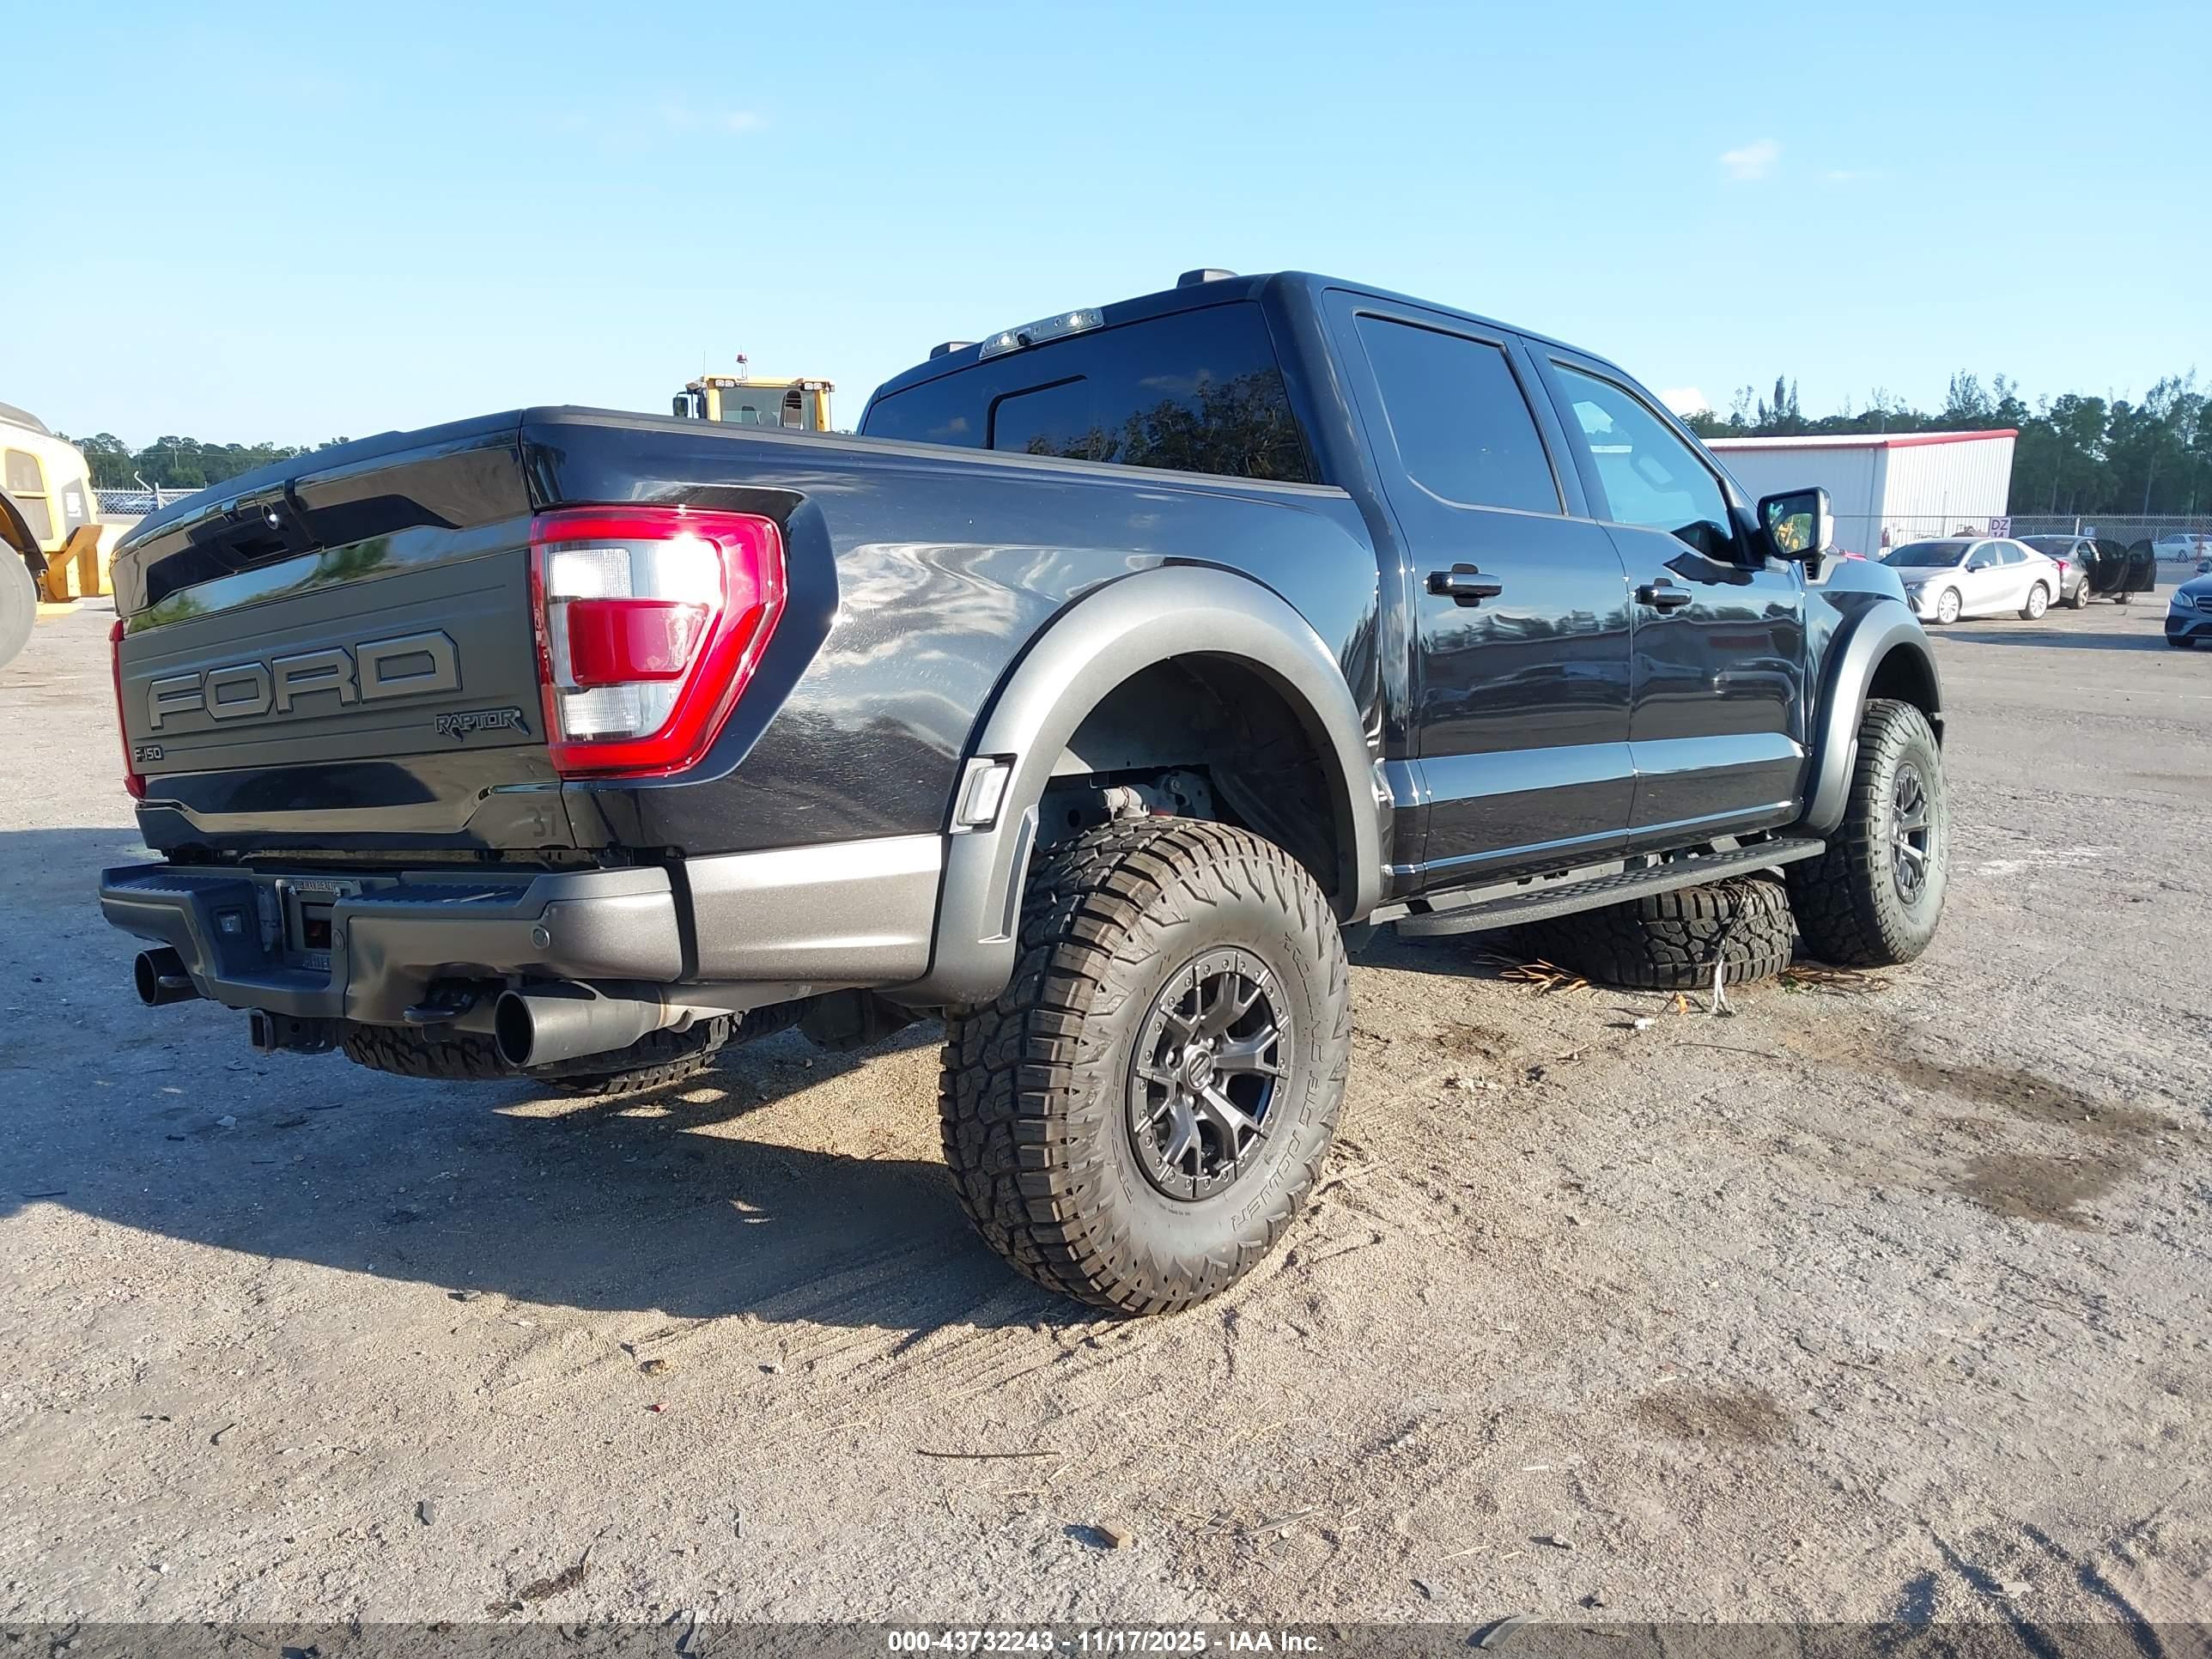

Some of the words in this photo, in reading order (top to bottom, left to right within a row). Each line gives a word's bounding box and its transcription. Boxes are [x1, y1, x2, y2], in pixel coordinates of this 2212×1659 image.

[1991, 519, 2009, 531] DZ
[147, 629, 464, 731] FORD
[434, 708, 531, 742] RAPTOR
[134, 746, 162, 762] F-150
